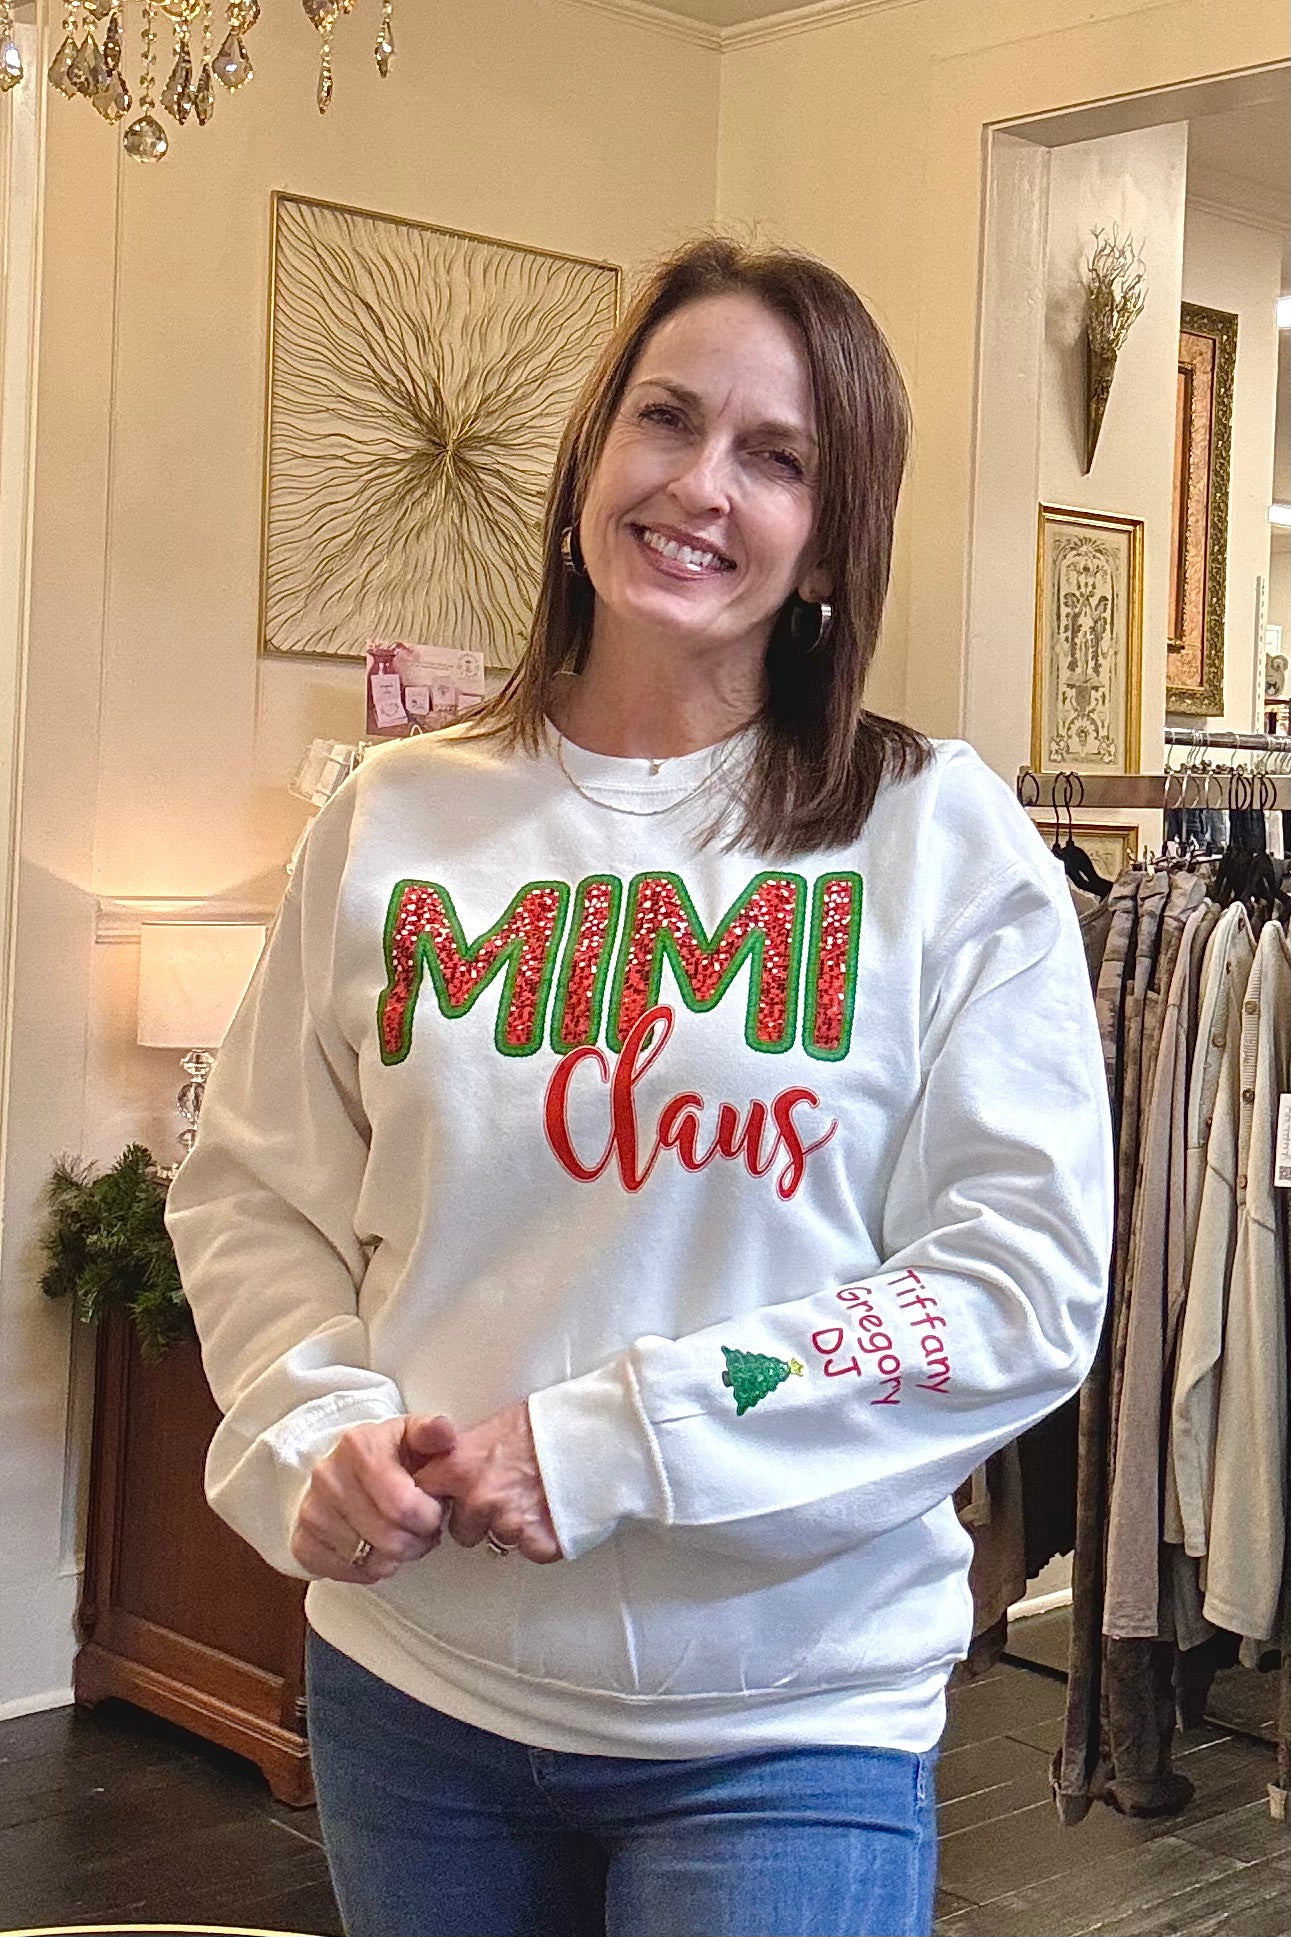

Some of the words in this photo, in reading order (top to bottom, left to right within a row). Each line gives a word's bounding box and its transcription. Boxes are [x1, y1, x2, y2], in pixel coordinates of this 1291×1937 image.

[378, 871, 863, 1065] MIMI
[544, 1005, 838, 1202] Claus
[812, 1327, 863, 1378] DJ
[836, 1286, 902, 1405] Gregory
[887, 1269, 952, 1393] Tiffany
